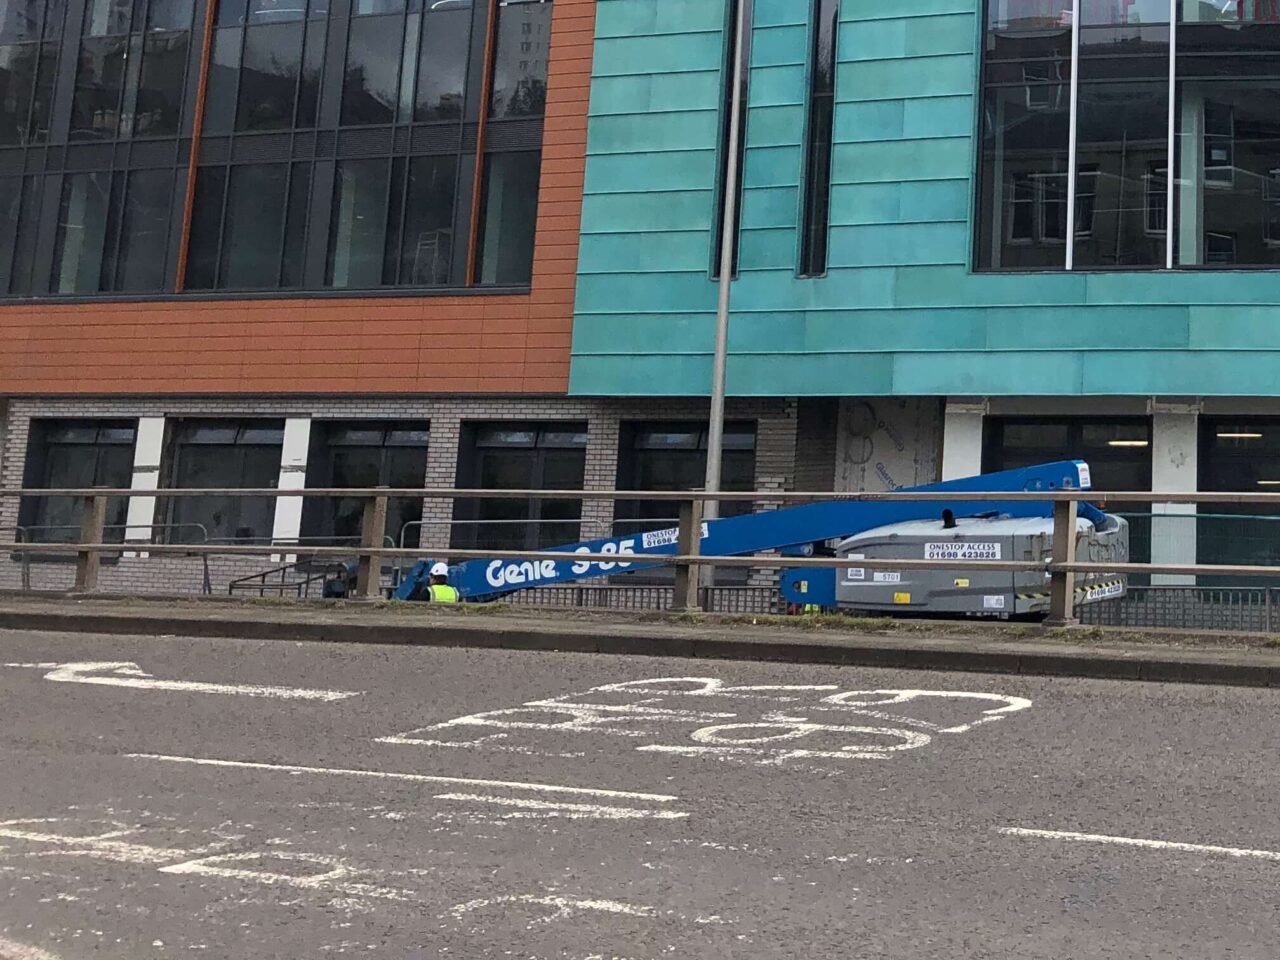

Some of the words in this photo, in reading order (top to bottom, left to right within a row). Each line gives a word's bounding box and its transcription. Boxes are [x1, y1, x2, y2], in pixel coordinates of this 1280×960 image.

[646, 528, 677, 540] ONESTOP
[929, 543, 965, 551] ONESTOP
[966, 543, 996, 551] ACCESS
[486, 560, 556, 587] Genie
